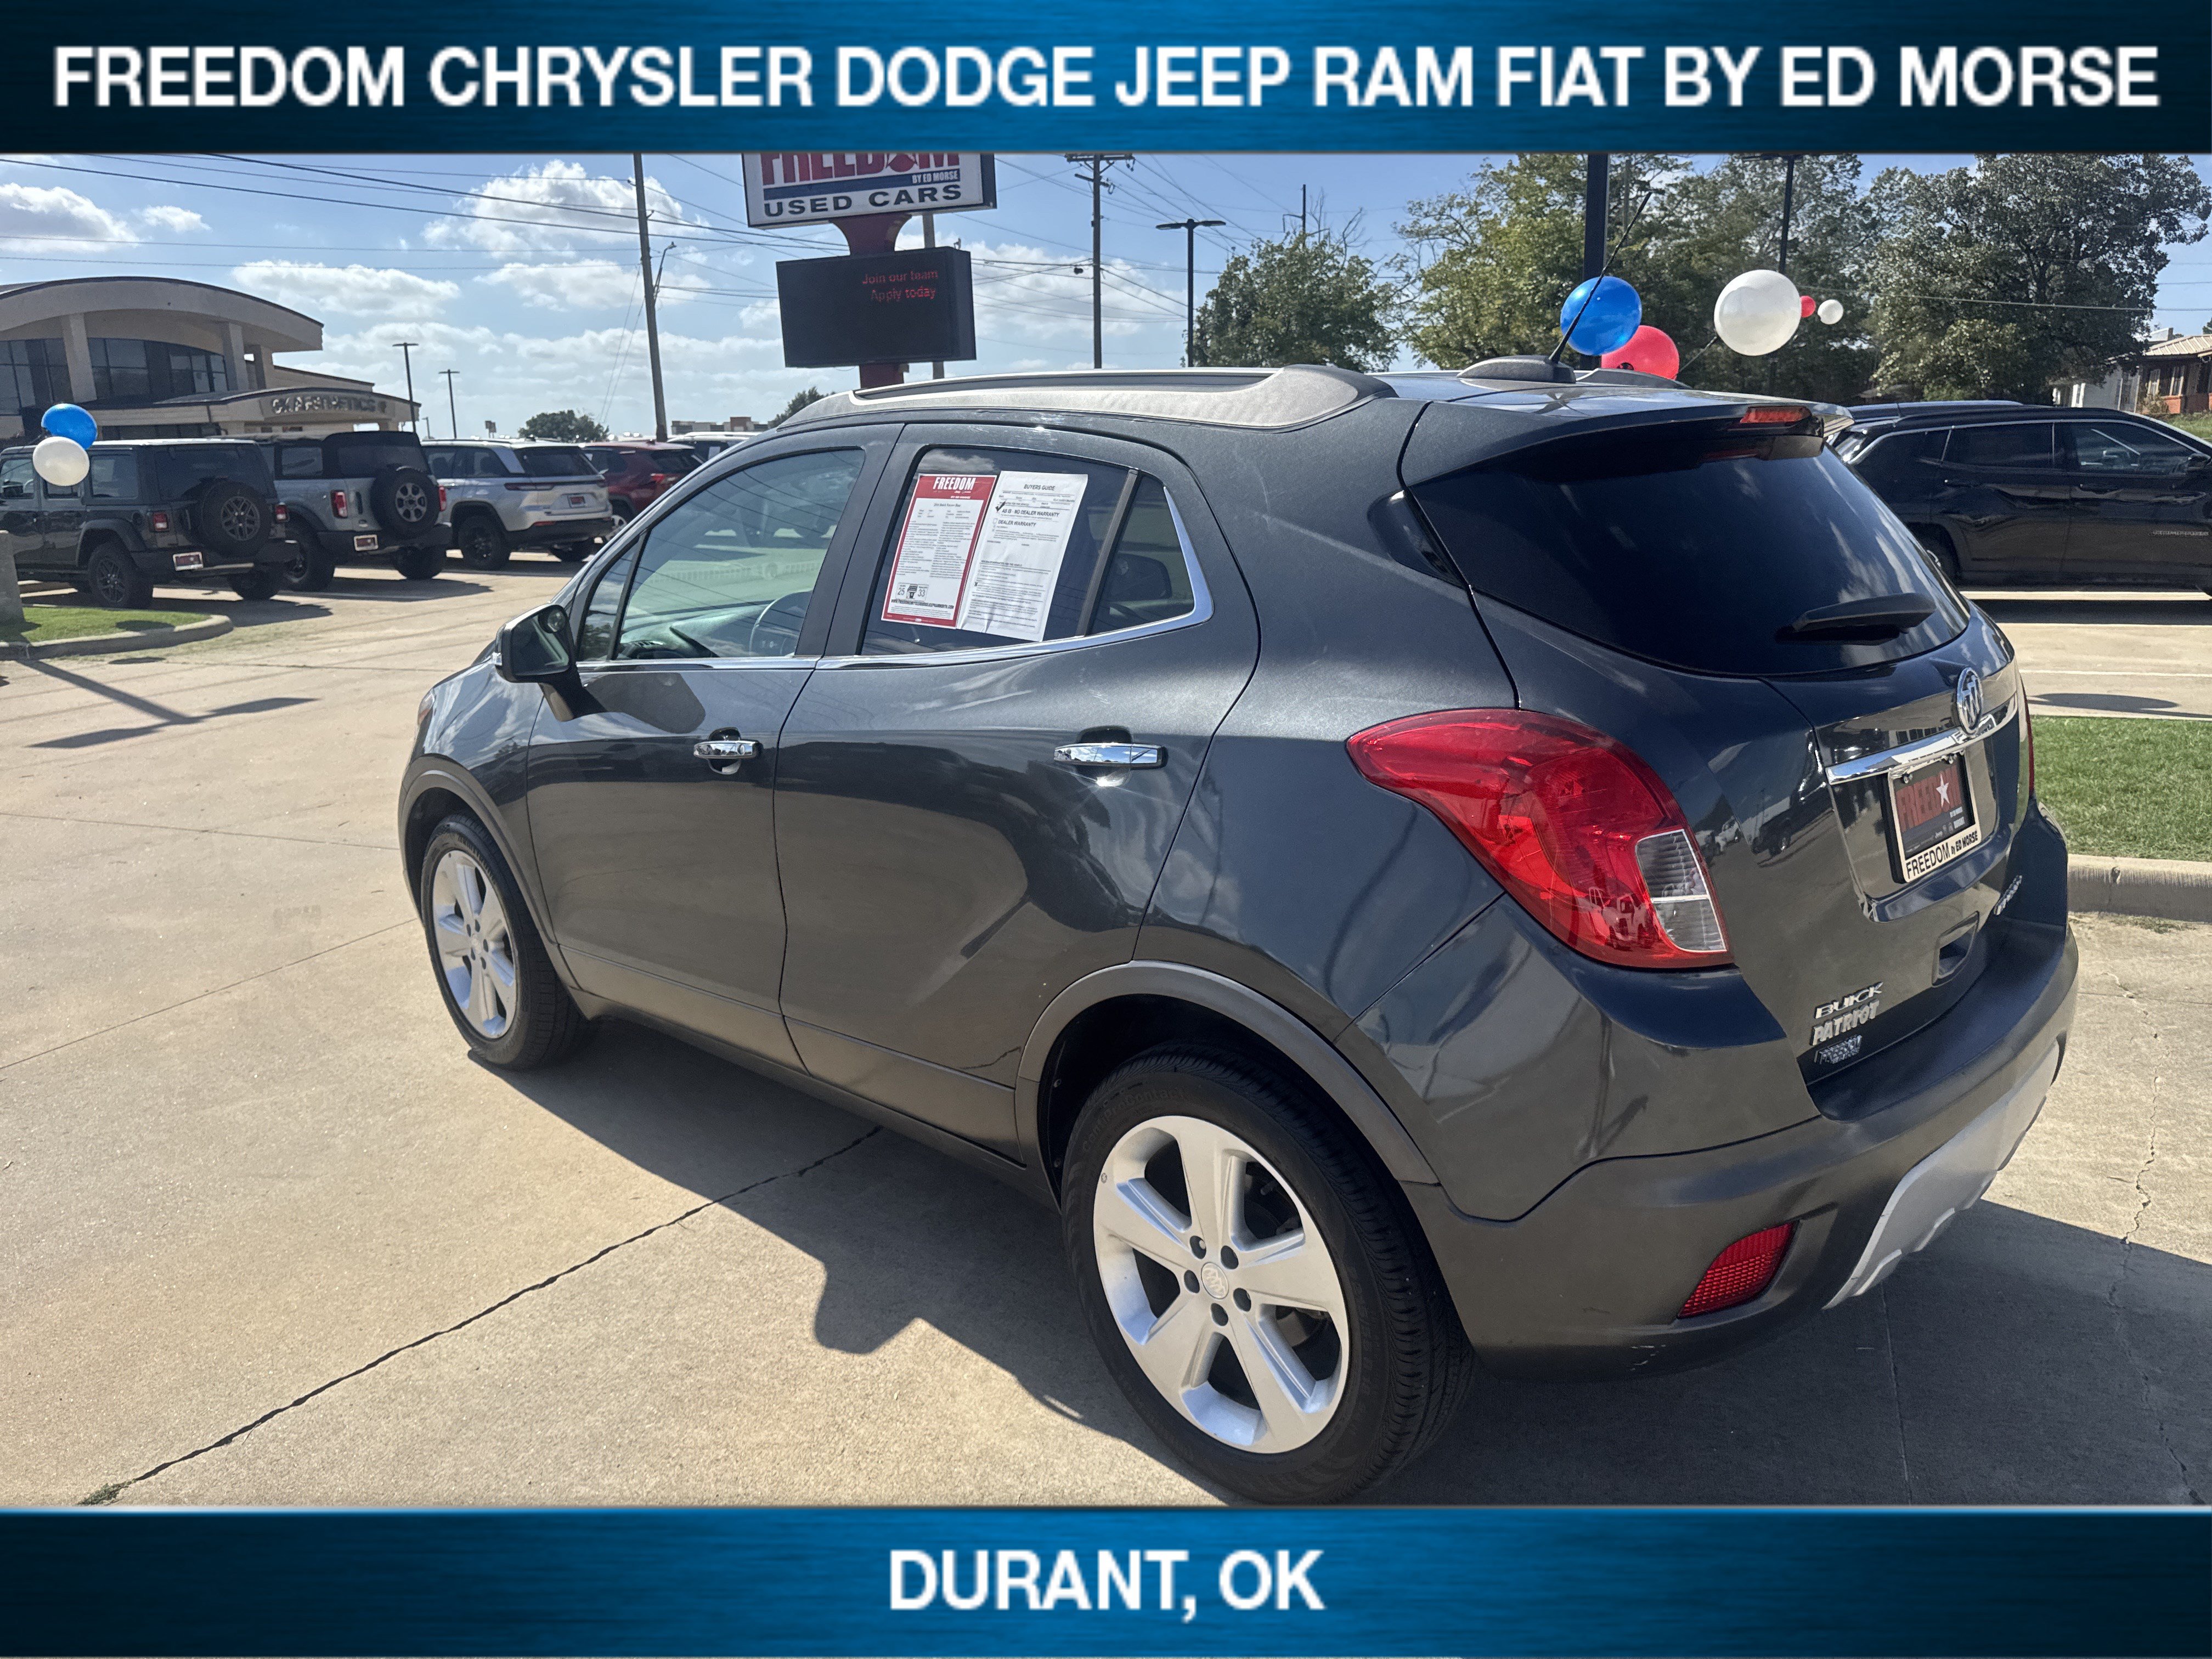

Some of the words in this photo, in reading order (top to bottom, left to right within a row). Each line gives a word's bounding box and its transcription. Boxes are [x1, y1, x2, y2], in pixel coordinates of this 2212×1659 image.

[912, 174, 922, 184] BY
[923, 173, 932, 183] ED
[933, 171, 958, 182] MORSE
[764, 196, 852, 217] USED
[868, 184, 962, 207] CARS
[862, 274, 885, 284] Join
[871, 288, 902, 302] Apply
[905, 286, 936, 299] today
[933, 477, 977, 490] FREEDOM
[898, 587, 905, 596] 25
[1906, 842, 1951, 879] FREEDOM
[1962, 830, 1978, 847] MORSE
[1814, 981, 1883, 1019] BUICK
[1811, 998, 1880, 1046] PATRIOT
